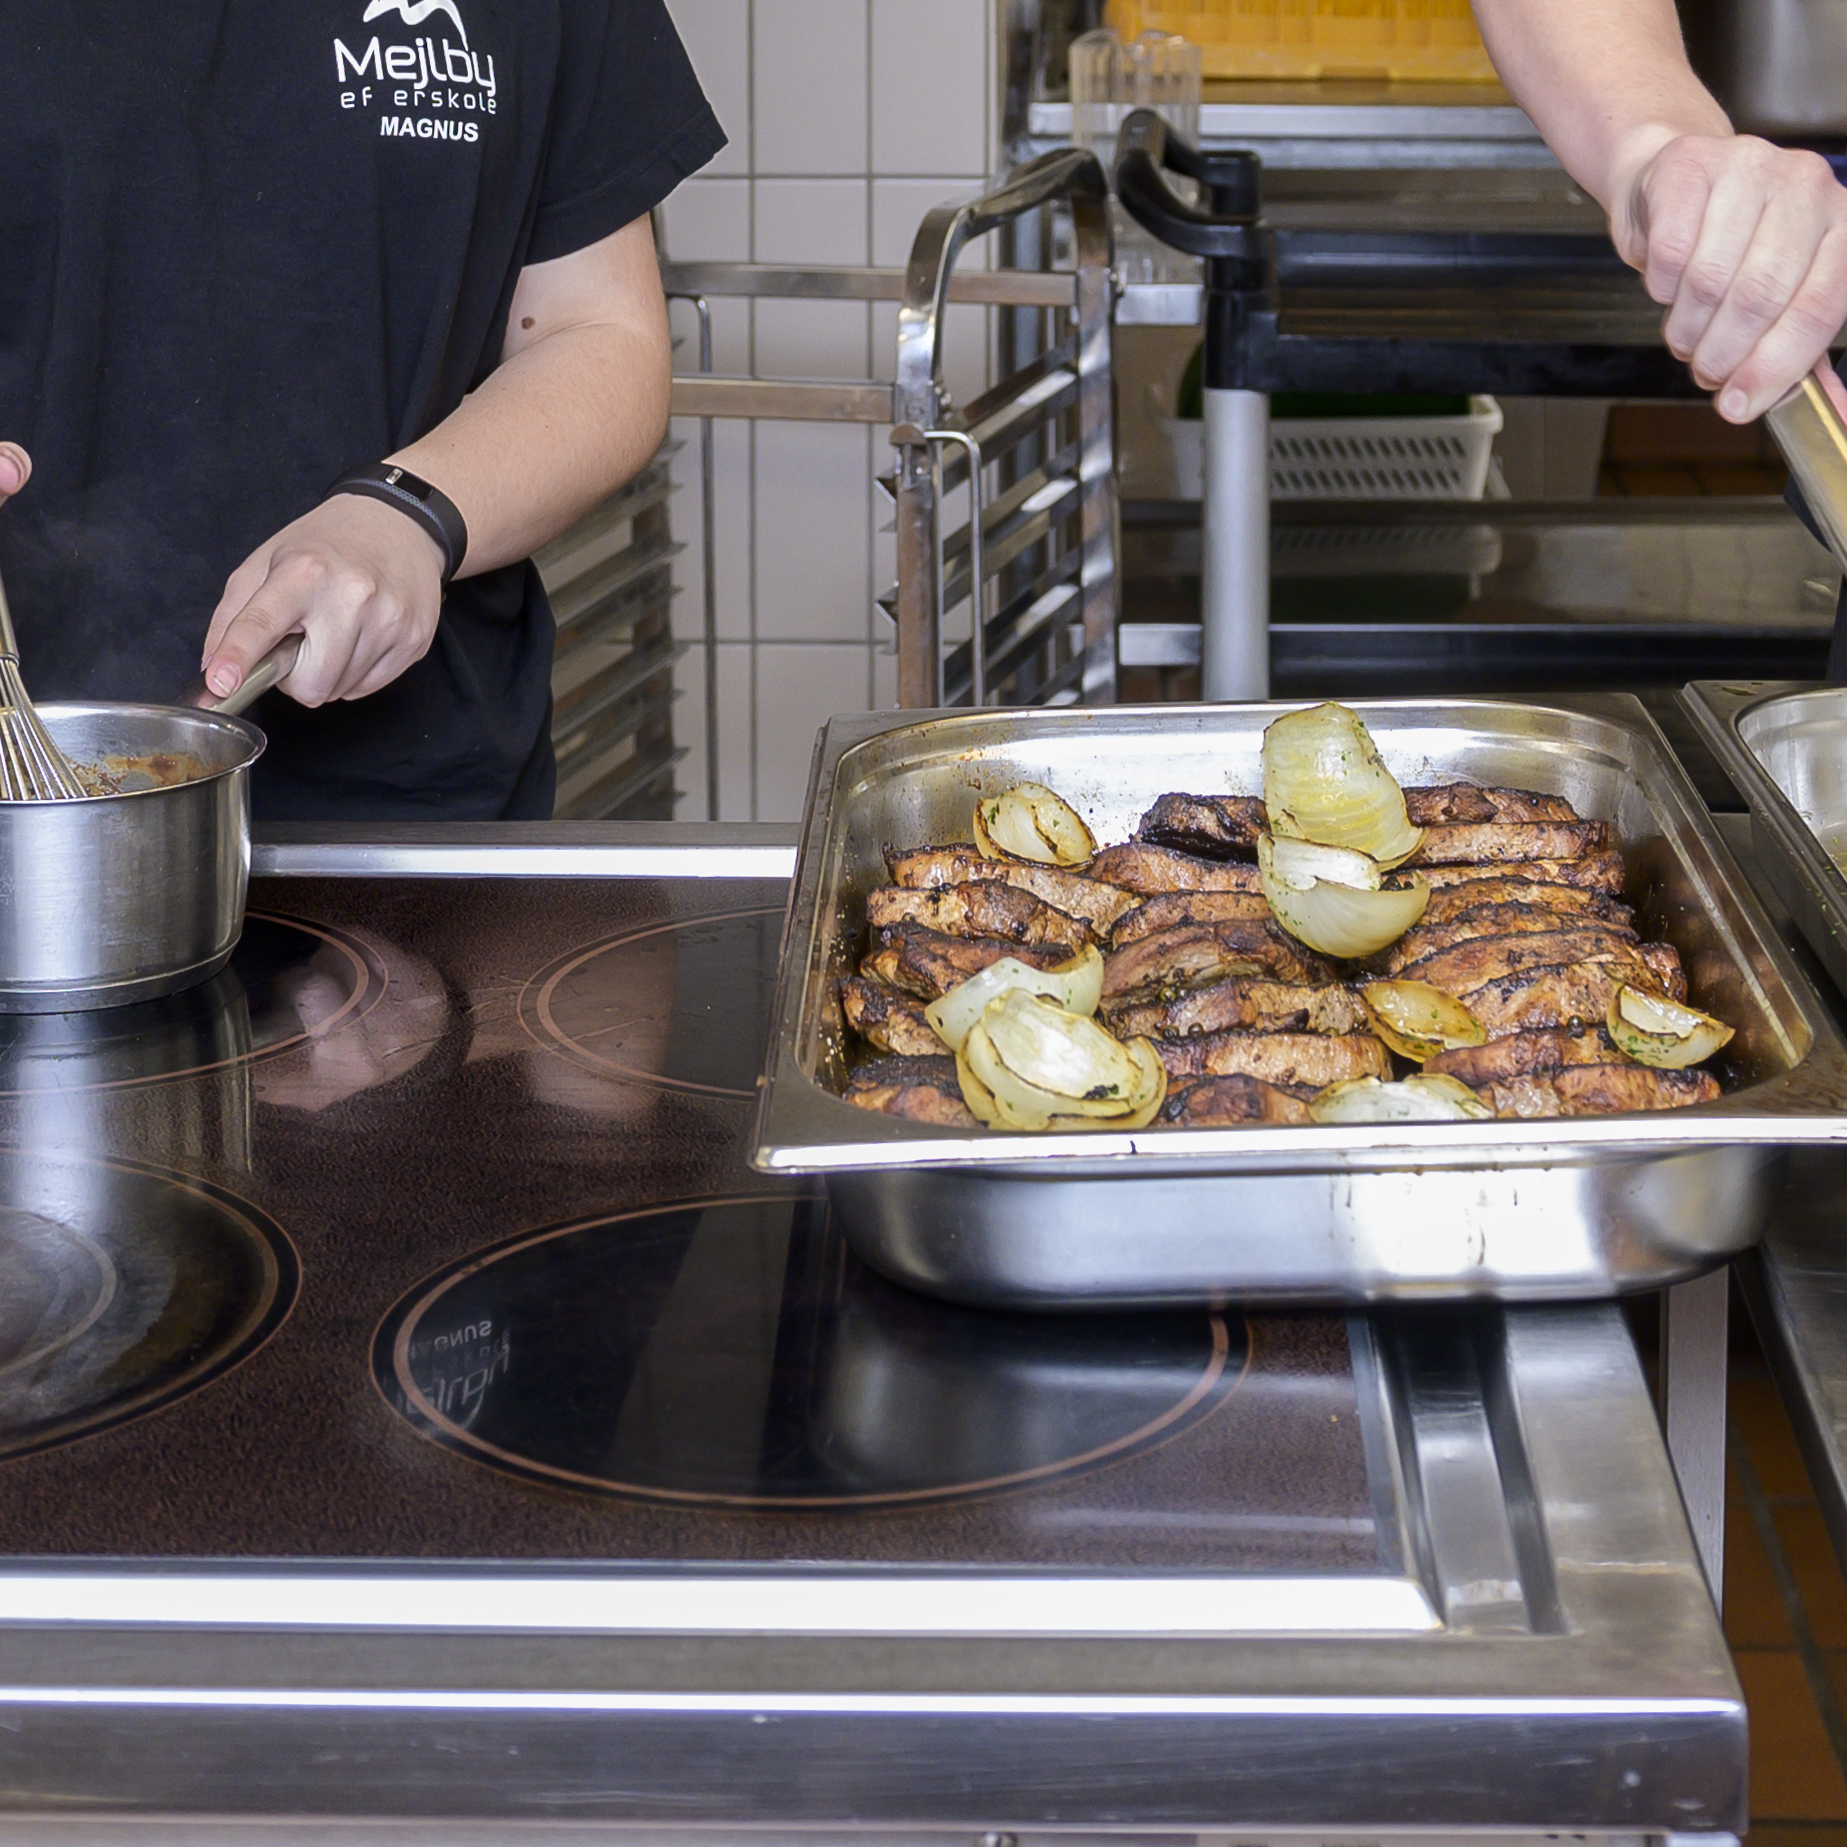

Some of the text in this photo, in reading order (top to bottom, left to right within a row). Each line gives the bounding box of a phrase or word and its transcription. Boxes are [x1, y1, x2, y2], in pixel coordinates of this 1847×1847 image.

[333, 35, 497, 98] Mejlby
[339, 85, 498, 115] eferskole
[379, 116, 479, 143] MAGNUS
